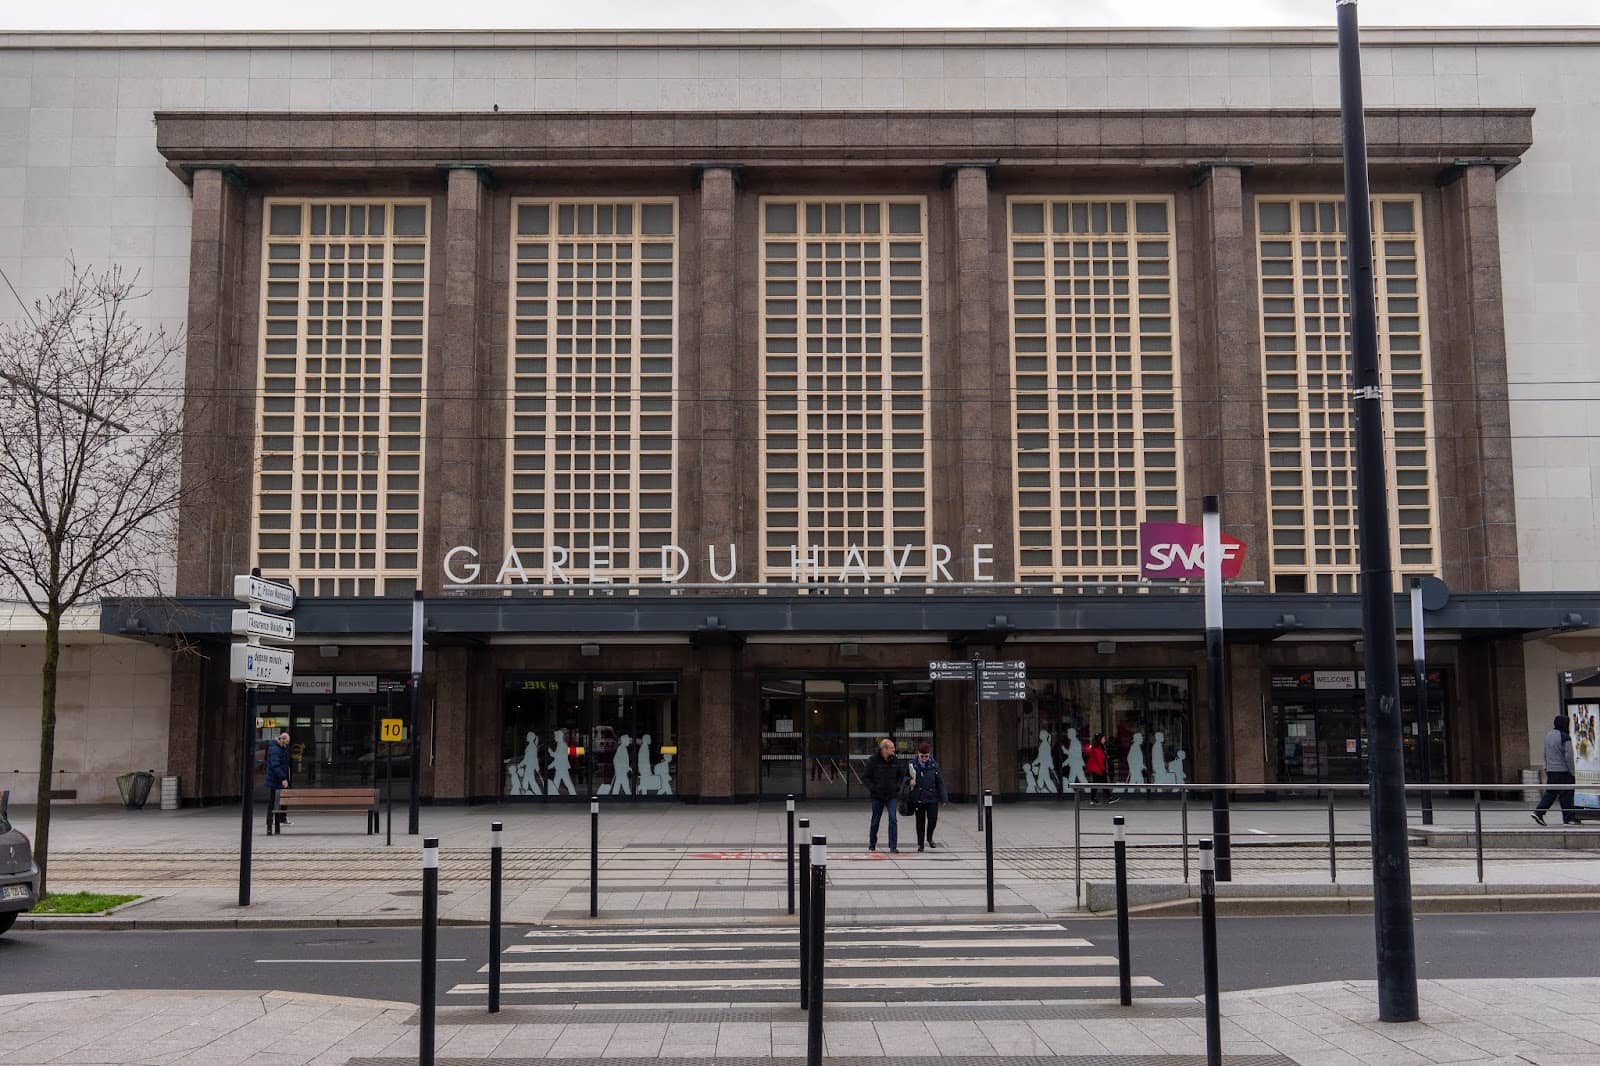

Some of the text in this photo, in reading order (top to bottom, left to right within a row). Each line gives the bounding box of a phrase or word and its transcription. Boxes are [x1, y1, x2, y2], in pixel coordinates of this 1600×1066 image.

[443, 543, 994, 584] GARE DU HAVRE
[1316, 675, 1351, 683] WELCOME
[295, 680, 331, 688] WELCOME
[338, 680, 376, 688] BIENVENUE
[384, 724, 401, 737] 10
